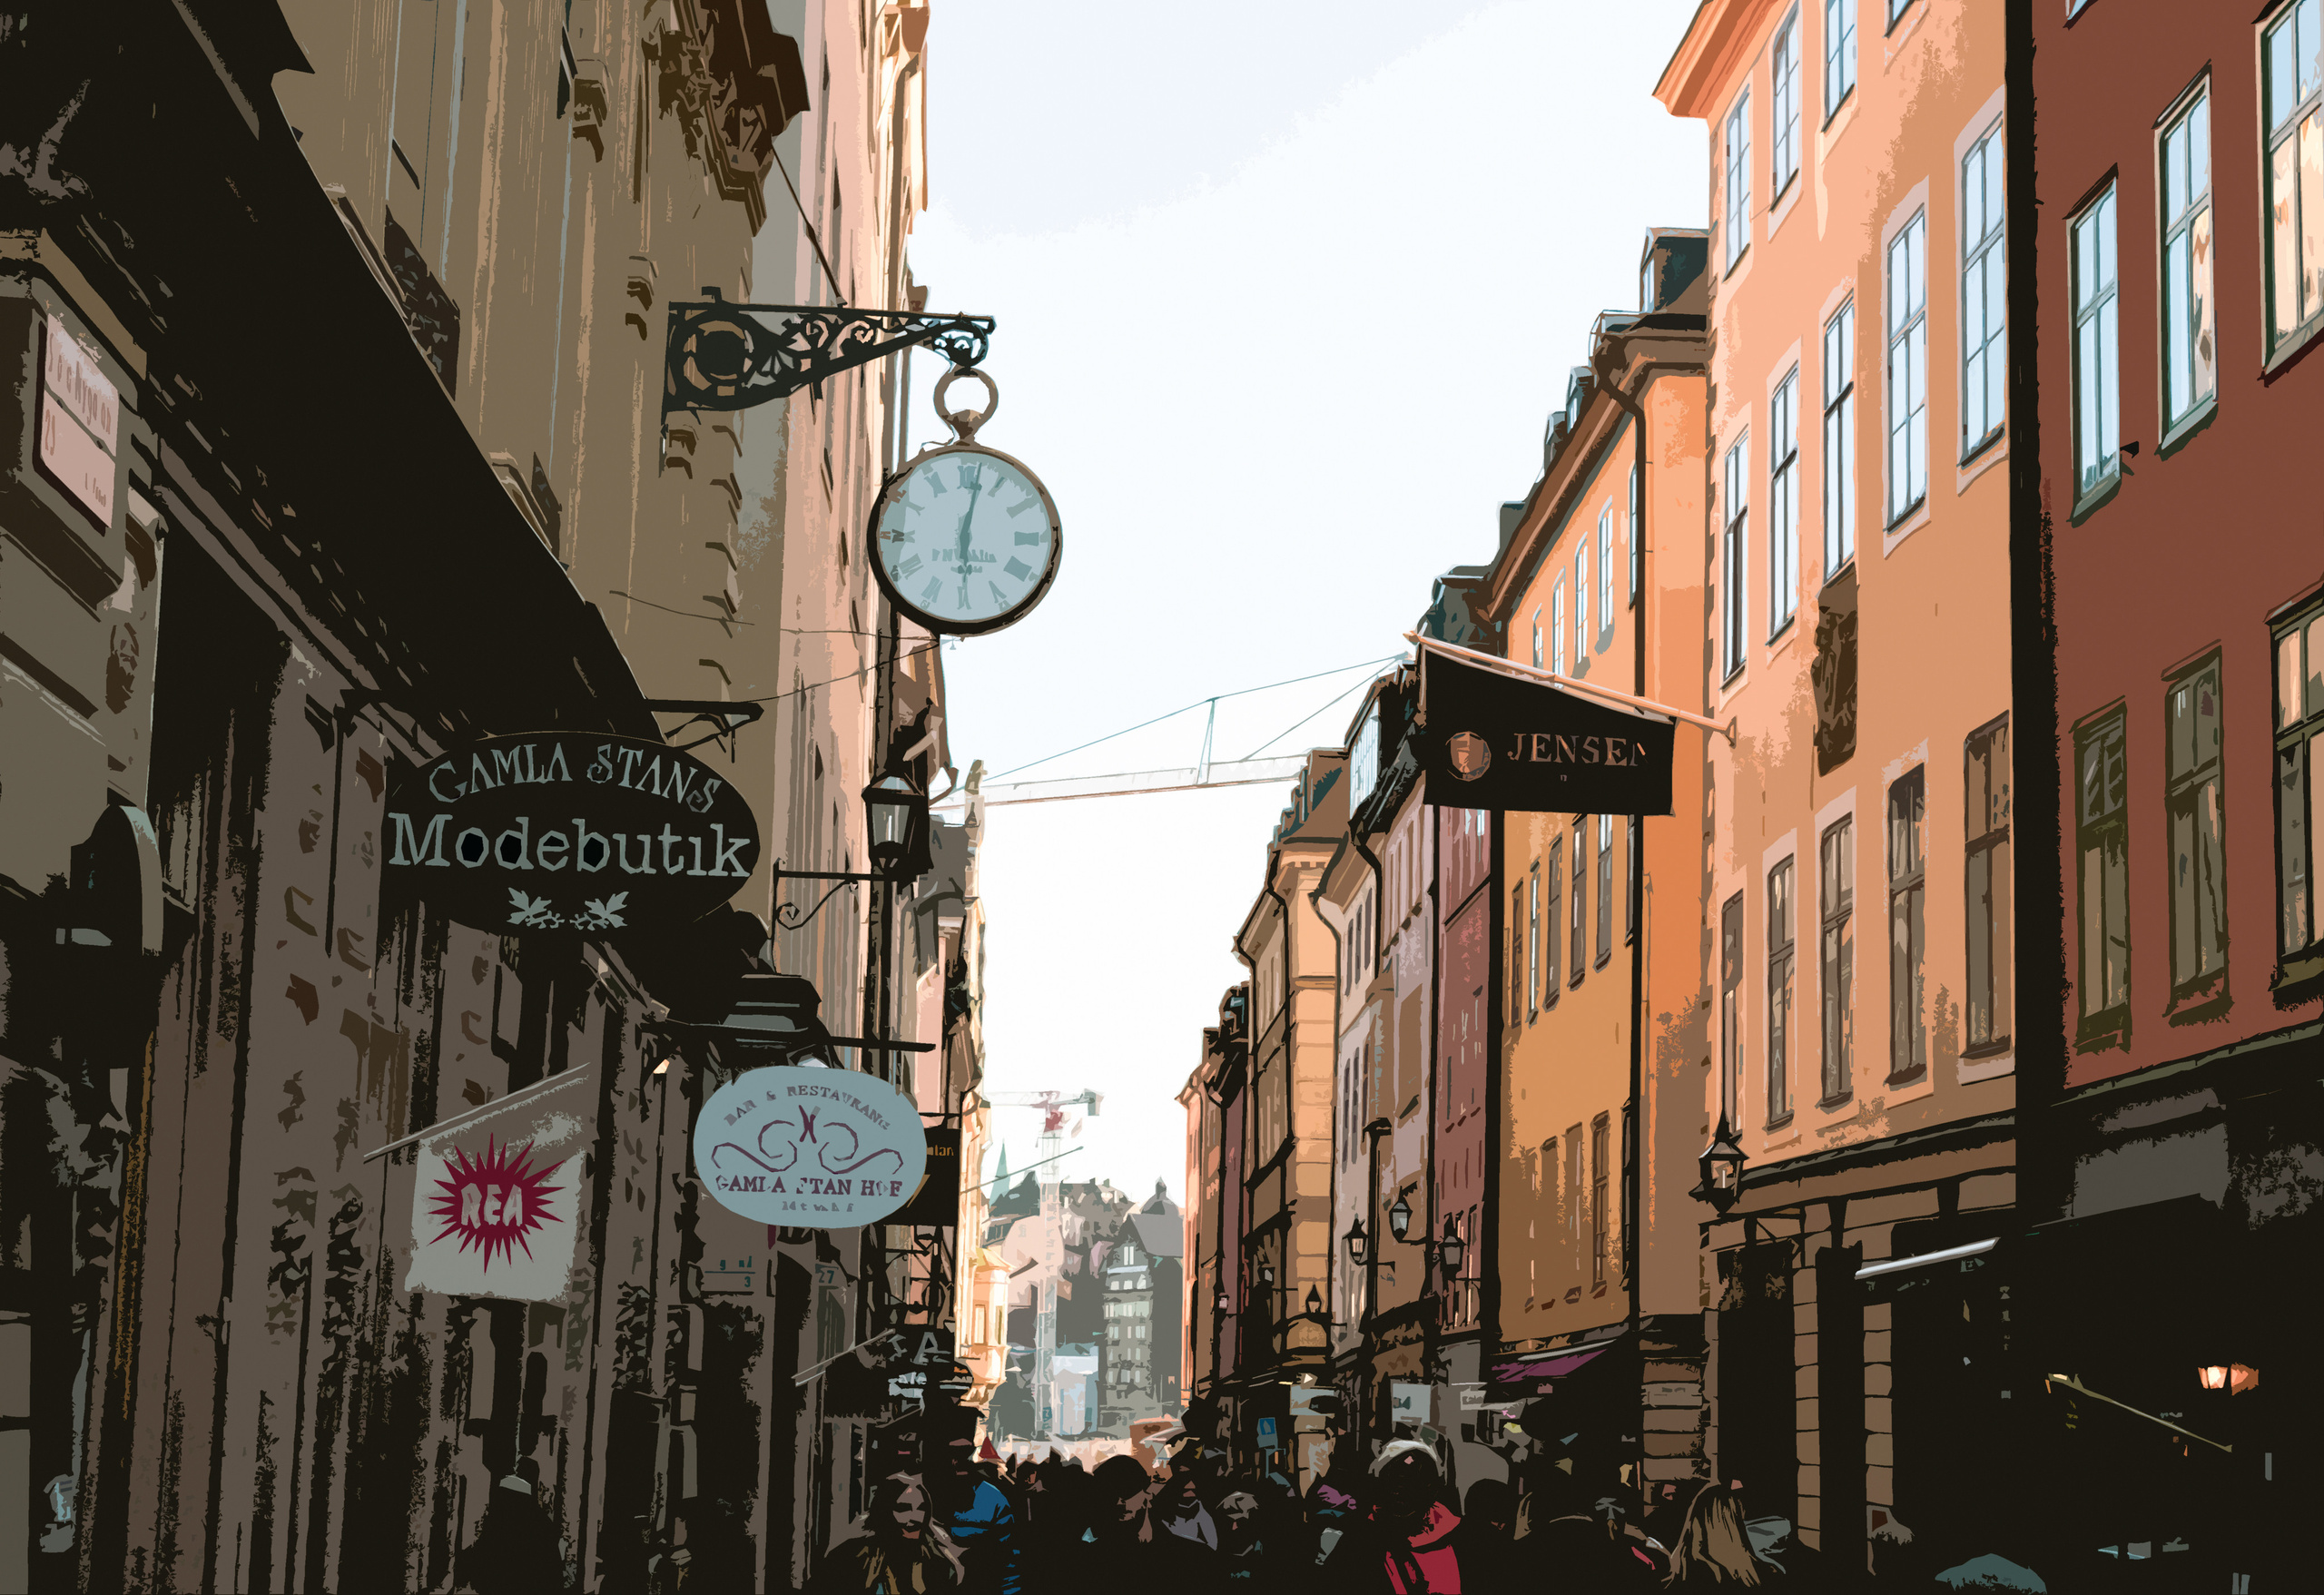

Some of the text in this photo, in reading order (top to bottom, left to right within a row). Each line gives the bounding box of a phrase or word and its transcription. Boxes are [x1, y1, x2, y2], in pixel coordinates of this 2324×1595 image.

[428, 742, 723, 813] GAMLA STANS
[388, 812, 752, 878] Modebutik
[460, 1182, 523, 1229] REA
